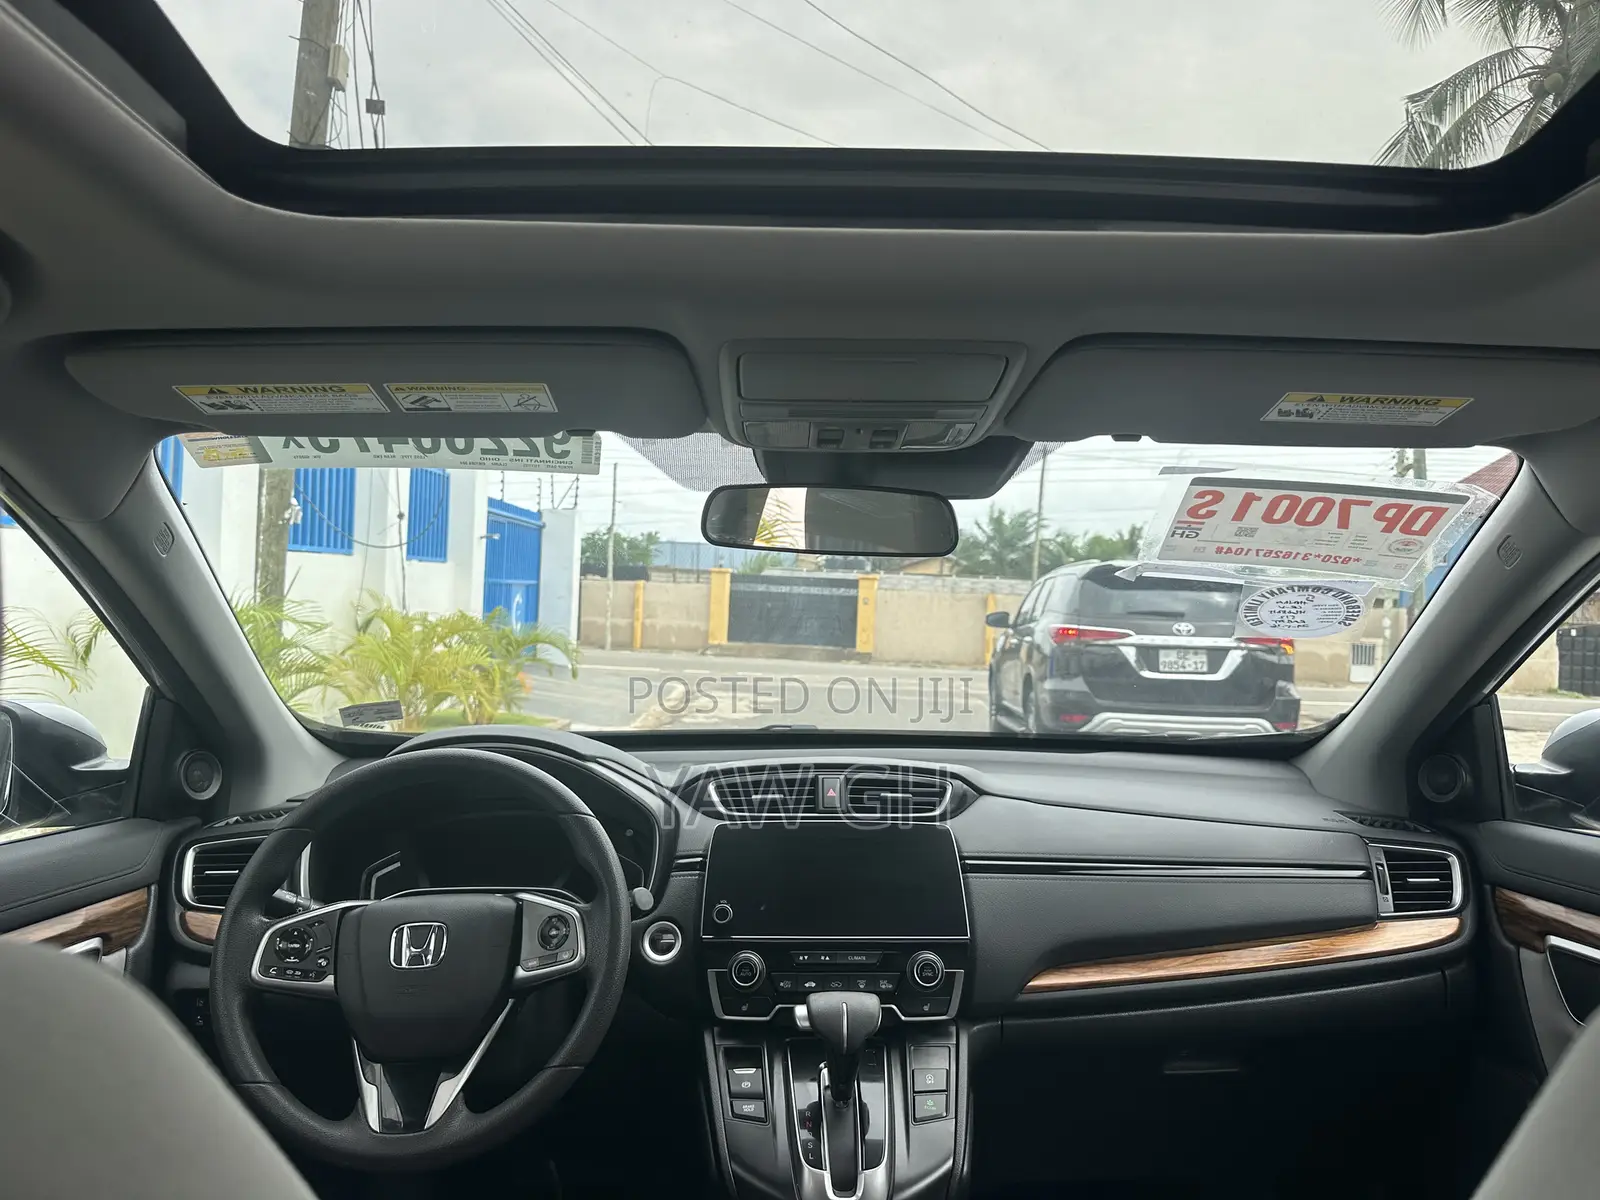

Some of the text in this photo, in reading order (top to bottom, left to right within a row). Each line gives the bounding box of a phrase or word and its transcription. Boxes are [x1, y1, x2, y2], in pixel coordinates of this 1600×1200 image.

[237, 385, 347, 395] WARNING
[1339, 395, 1442, 406] WARNING
[1160, 660, 1206, 670] 9854-17
[805, 1120, 812, 1128] N
[808, 1152, 814, 1160] L
